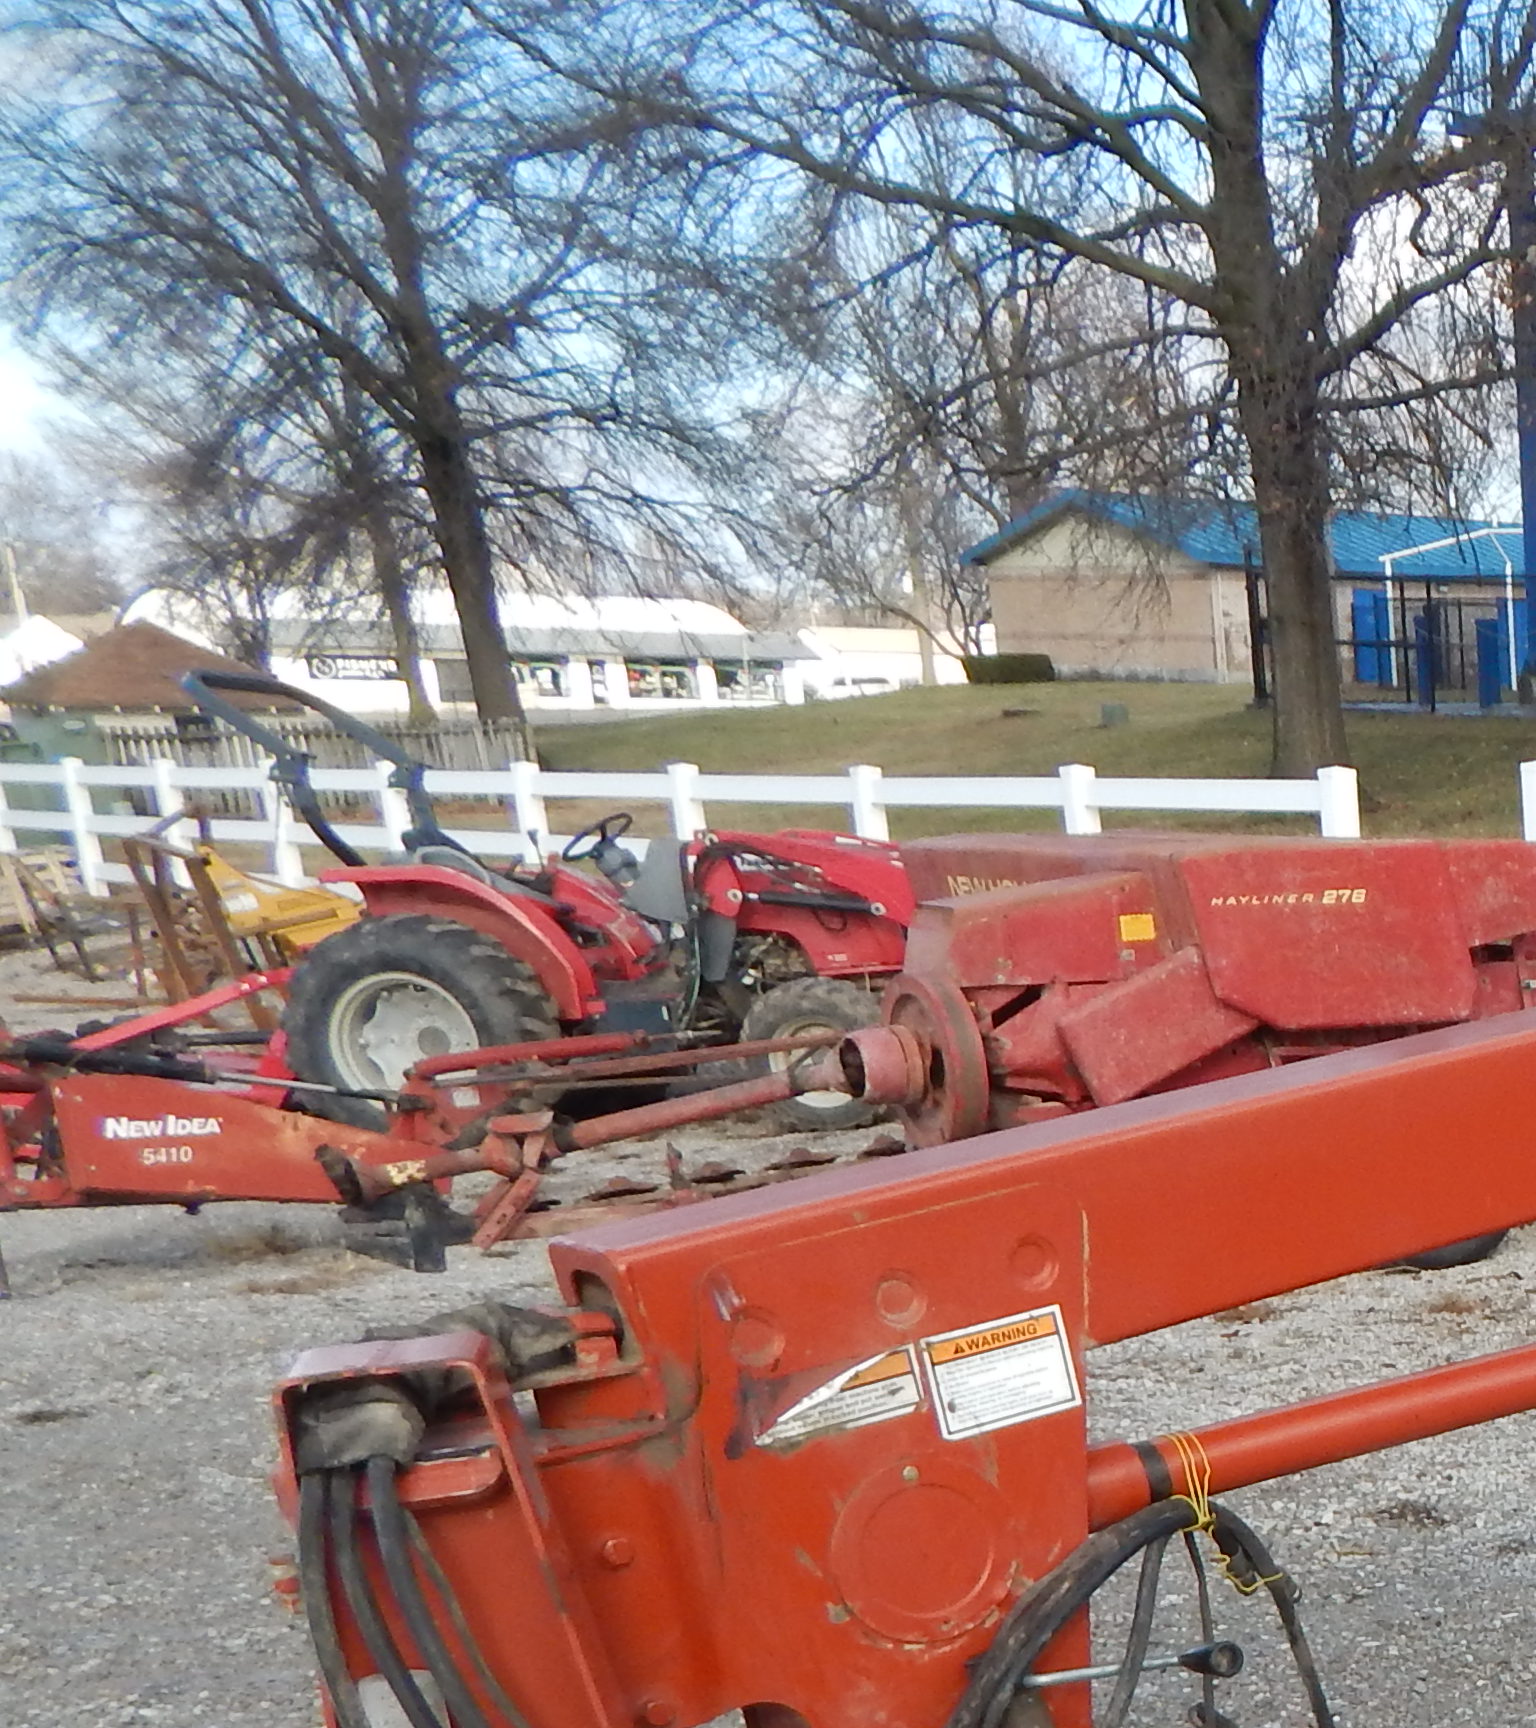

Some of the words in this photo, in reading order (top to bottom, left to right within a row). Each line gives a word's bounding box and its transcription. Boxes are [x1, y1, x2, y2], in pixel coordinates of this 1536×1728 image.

[1211, 894, 1314, 905] HAYLINER
[143, 1146, 193, 1165] 5410
[966, 1323, 1038, 1351] WARNING
